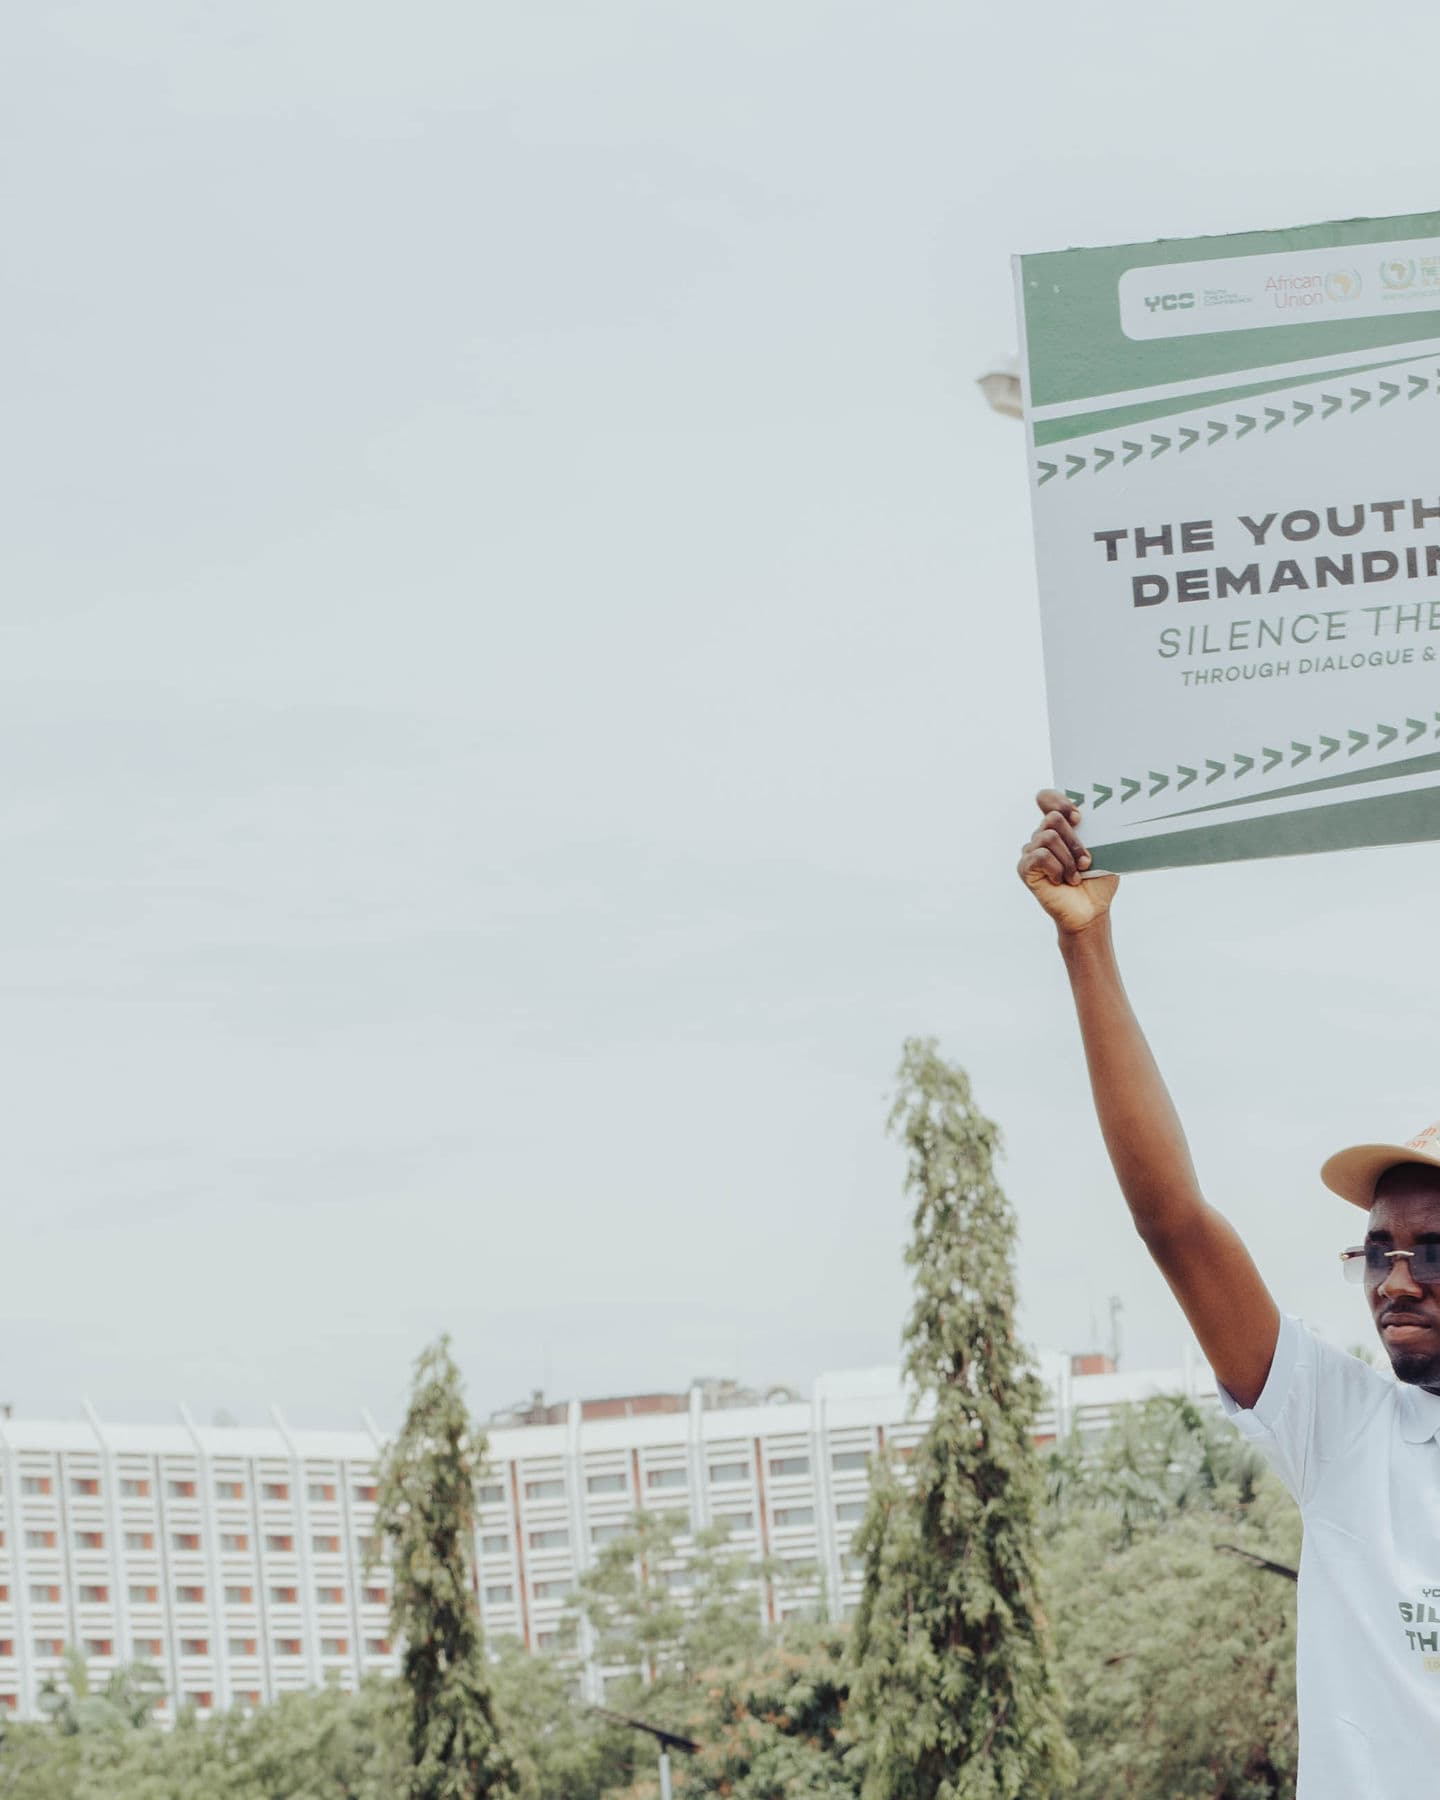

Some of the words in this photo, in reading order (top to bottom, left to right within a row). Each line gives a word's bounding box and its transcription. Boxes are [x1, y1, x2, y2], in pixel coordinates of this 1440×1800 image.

[1264, 274, 1322, 291] African
[1275, 292, 1323, 309] Union
[1093, 519, 1215, 562] THE
[1157, 610, 1351, 659] SILENCE
[1181, 660, 1290, 687] THROUGH
[1298, 647, 1415, 675] DIALOGUE
[1422, 646, 1436, 662] &
